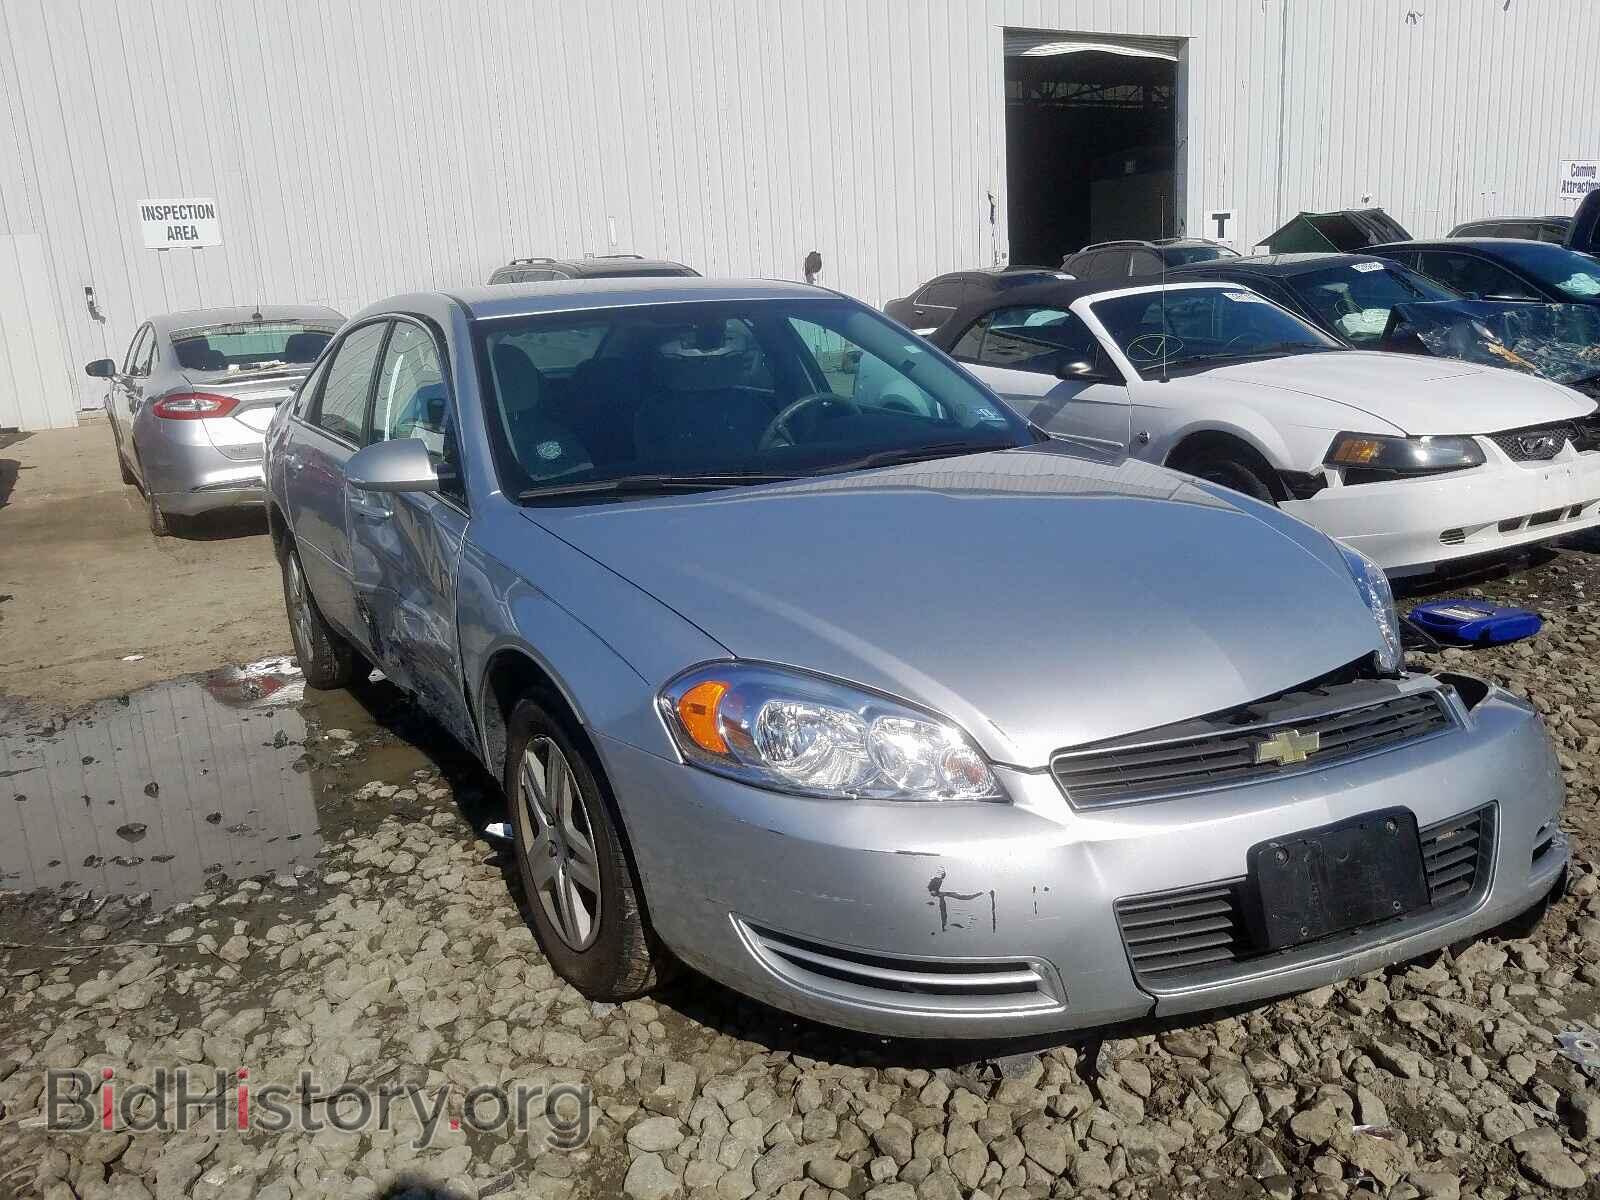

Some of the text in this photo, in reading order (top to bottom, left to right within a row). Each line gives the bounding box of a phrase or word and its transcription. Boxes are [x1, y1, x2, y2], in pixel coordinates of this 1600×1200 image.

[1570, 163, 1597, 179] Coming
[141, 203, 215, 221] INSPECTION
[167, 225, 199, 241] AREA
[1211, 212, 1231, 239] T
